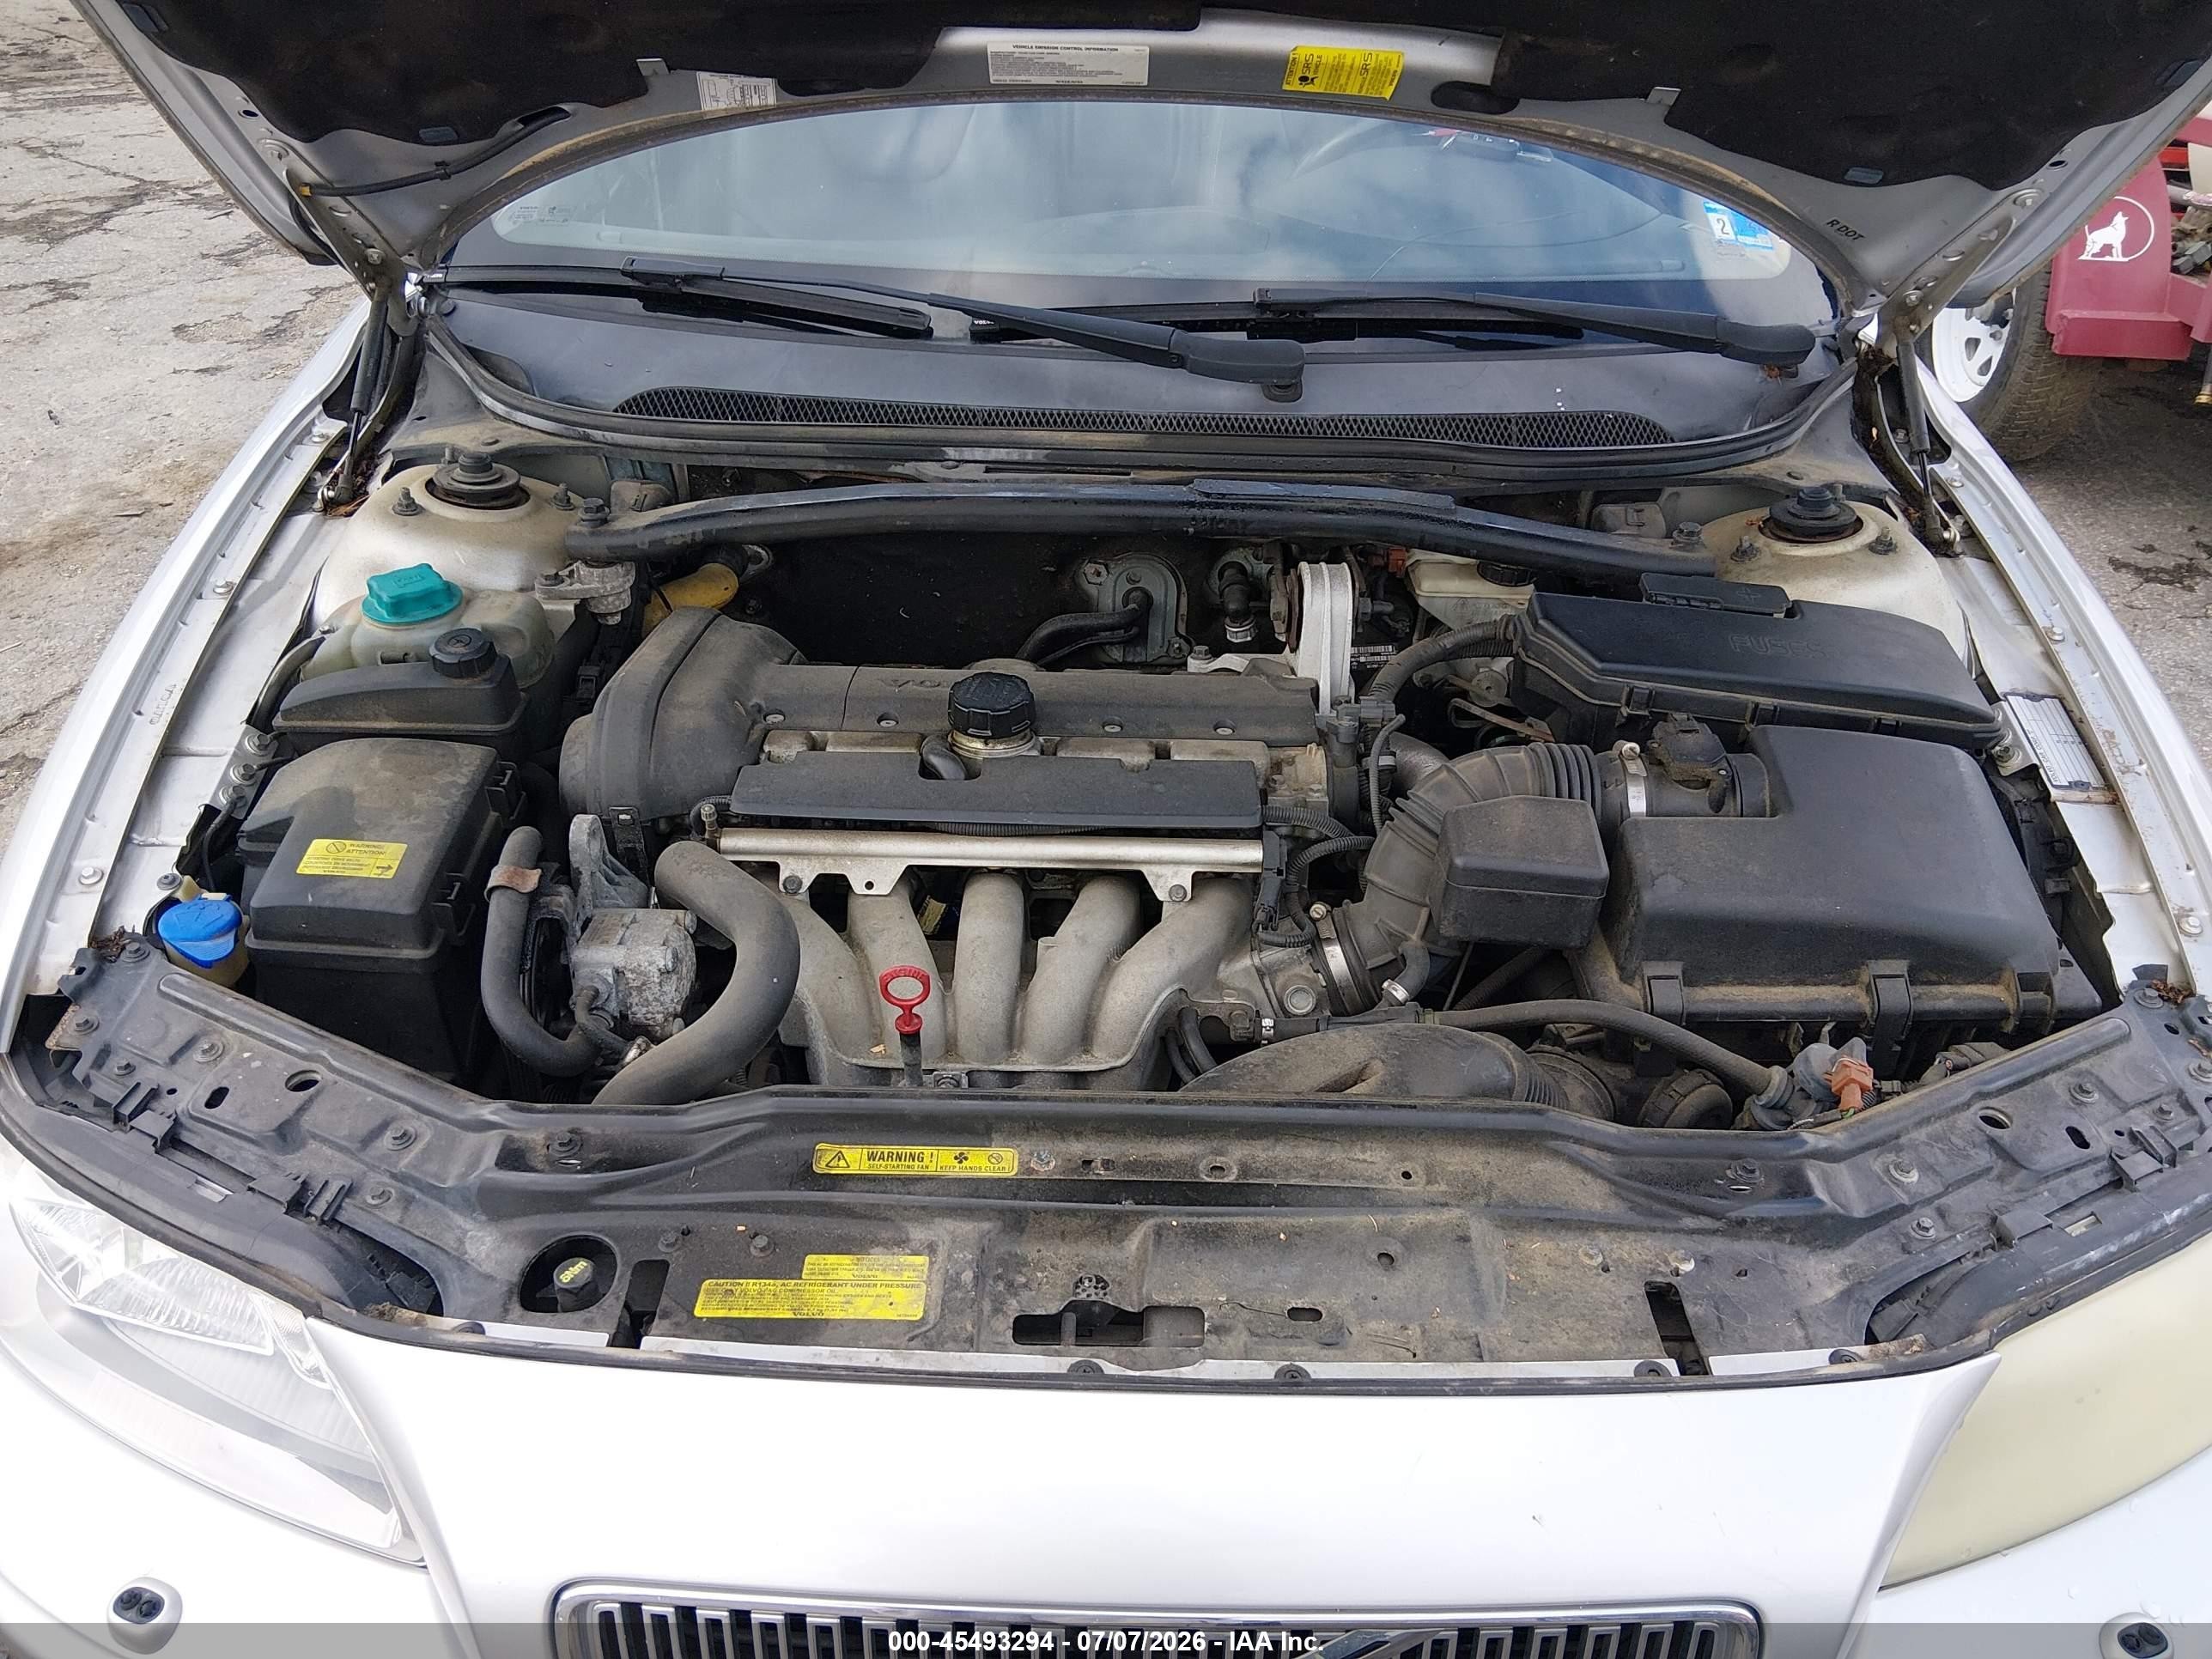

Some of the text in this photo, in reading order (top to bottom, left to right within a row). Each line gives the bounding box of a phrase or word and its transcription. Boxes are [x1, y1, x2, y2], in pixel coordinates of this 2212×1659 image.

[1302, 53, 1314, 75] SRS
[1360, 52, 1372, 76] SRS
[1717, 218, 1730, 235] 2
[1826, 219, 1865, 241] R DOT
[867, 1151, 925, 1163] WARNING
[559, 1261, 587, 1283] 8Nm
